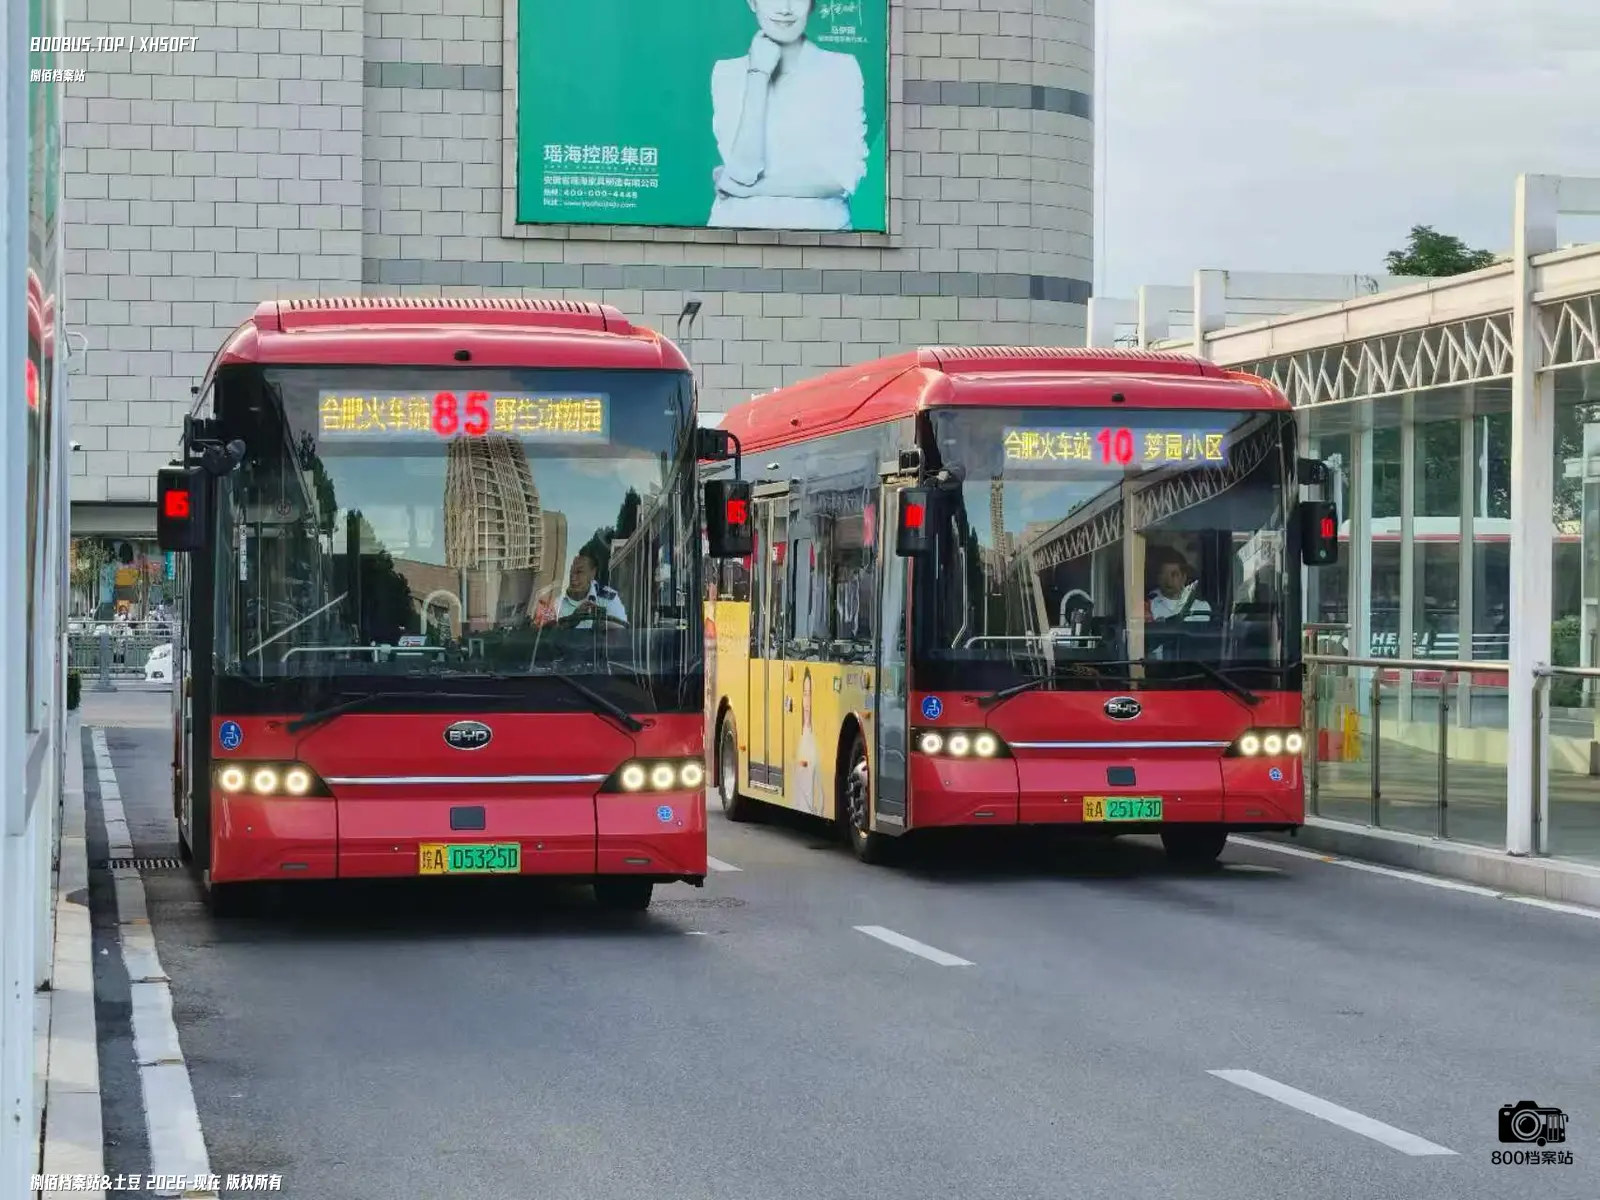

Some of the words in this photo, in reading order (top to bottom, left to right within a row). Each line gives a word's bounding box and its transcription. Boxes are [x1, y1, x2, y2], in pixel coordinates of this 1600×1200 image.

[543, 144, 658, 166] 瑶海控股集团
[320, 396, 431, 431] 合肥火车站
[431, 391, 491, 437] 85
[1004, 430, 1093, 461] 合肥火车站
[1097, 426, 1136, 466] 10
[1107, 703, 1139, 713] BYD
[449, 730, 488, 741] BYD
